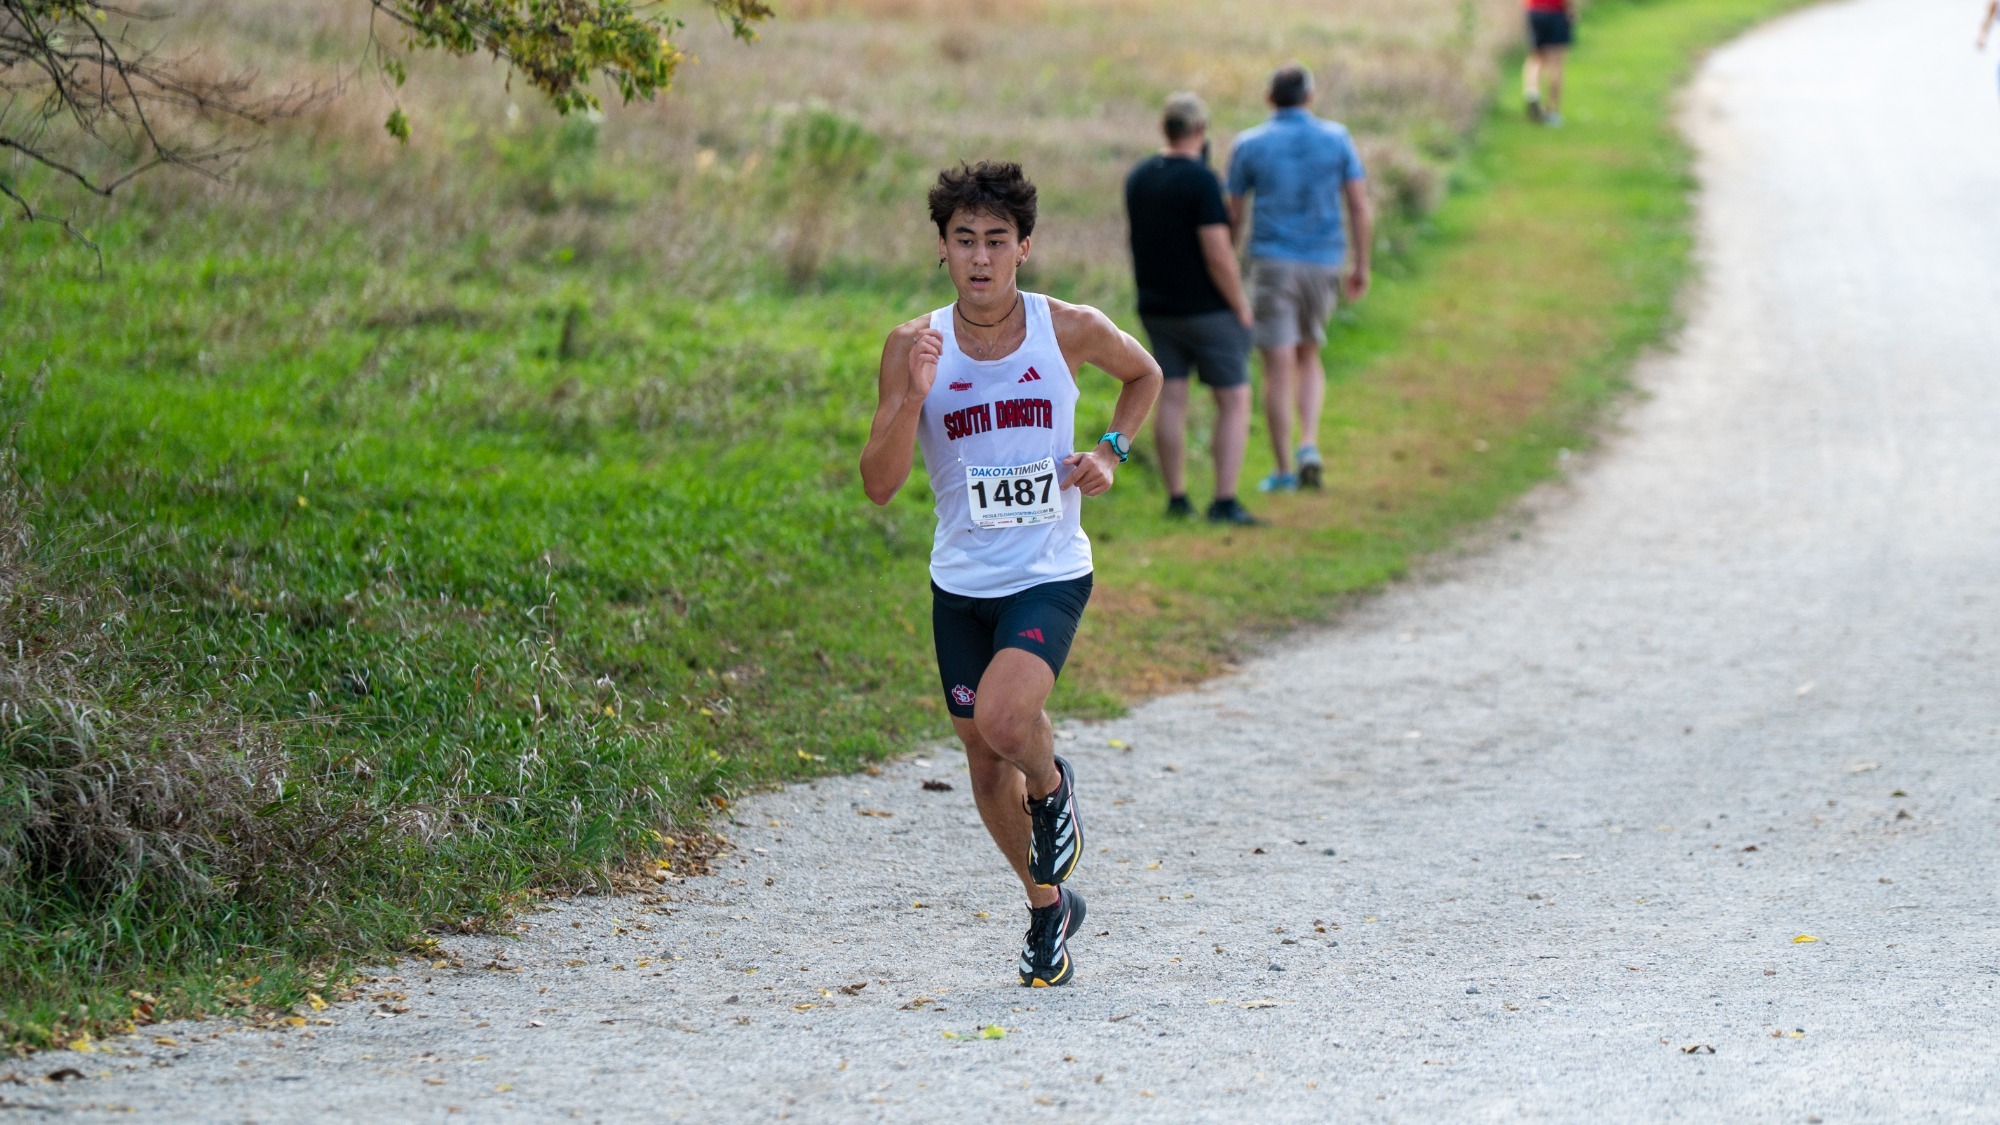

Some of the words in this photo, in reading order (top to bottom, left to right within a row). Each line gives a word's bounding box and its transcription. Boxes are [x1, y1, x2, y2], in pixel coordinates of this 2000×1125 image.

[944, 403, 992, 440] SOUTH
[995, 398, 1053, 429] DAKOTA
[971, 473, 1053, 508] 1487
